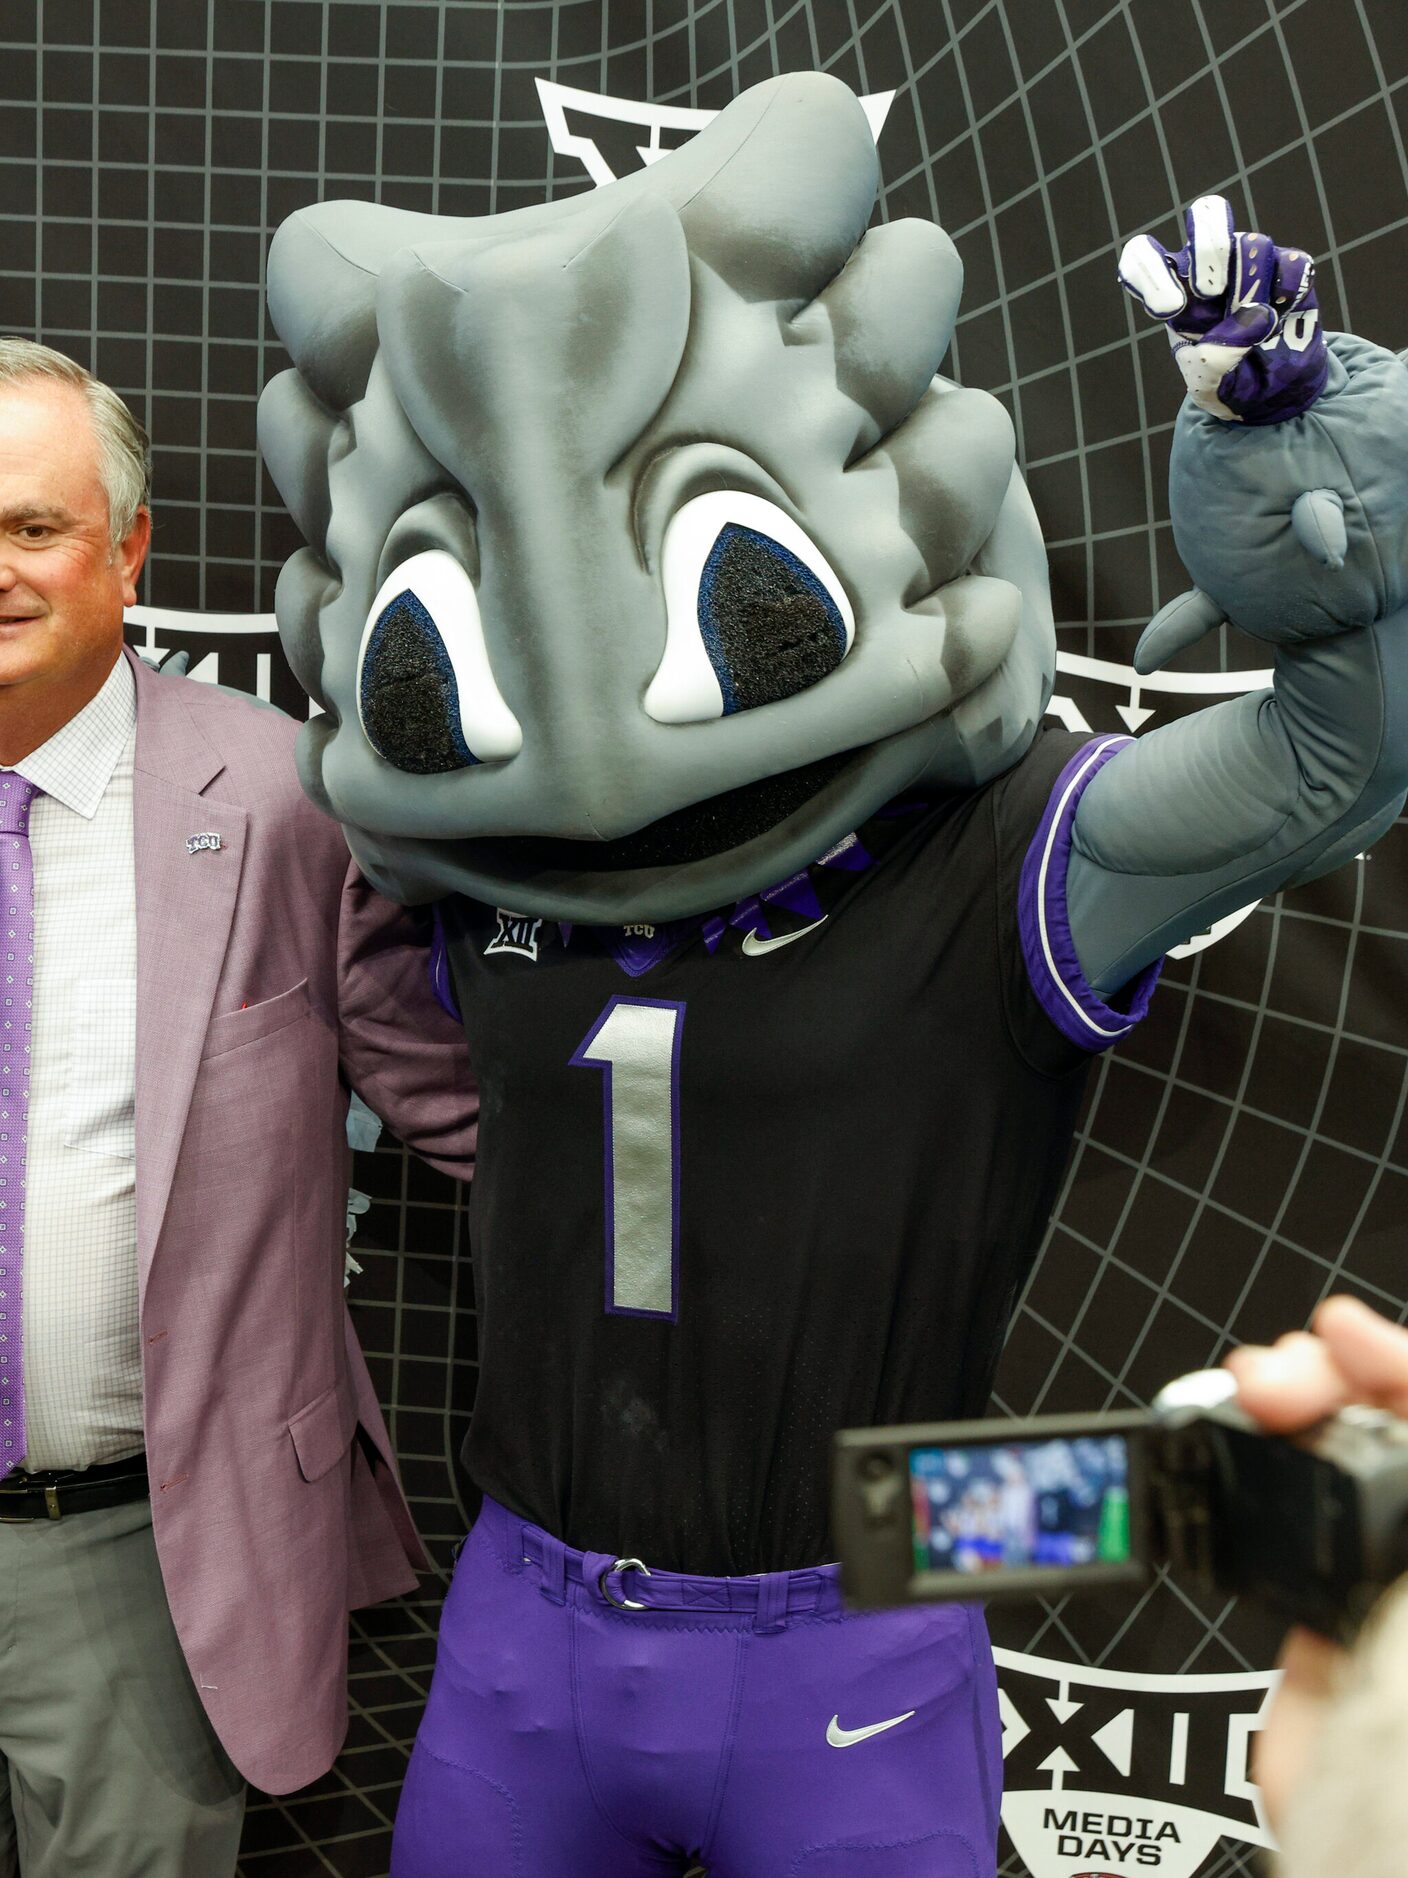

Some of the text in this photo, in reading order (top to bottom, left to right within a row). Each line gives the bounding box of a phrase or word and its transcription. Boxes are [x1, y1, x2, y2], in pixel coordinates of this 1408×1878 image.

[185, 833, 221, 854] TCU
[491, 914, 539, 953] XII
[623, 924, 655, 939] TCU
[568, 994, 687, 1326] 1
[994, 1664, 1269, 1829] XII
[1043, 1808, 1181, 1843] MEDIA
[1057, 1834, 1162, 1867] DAYS
